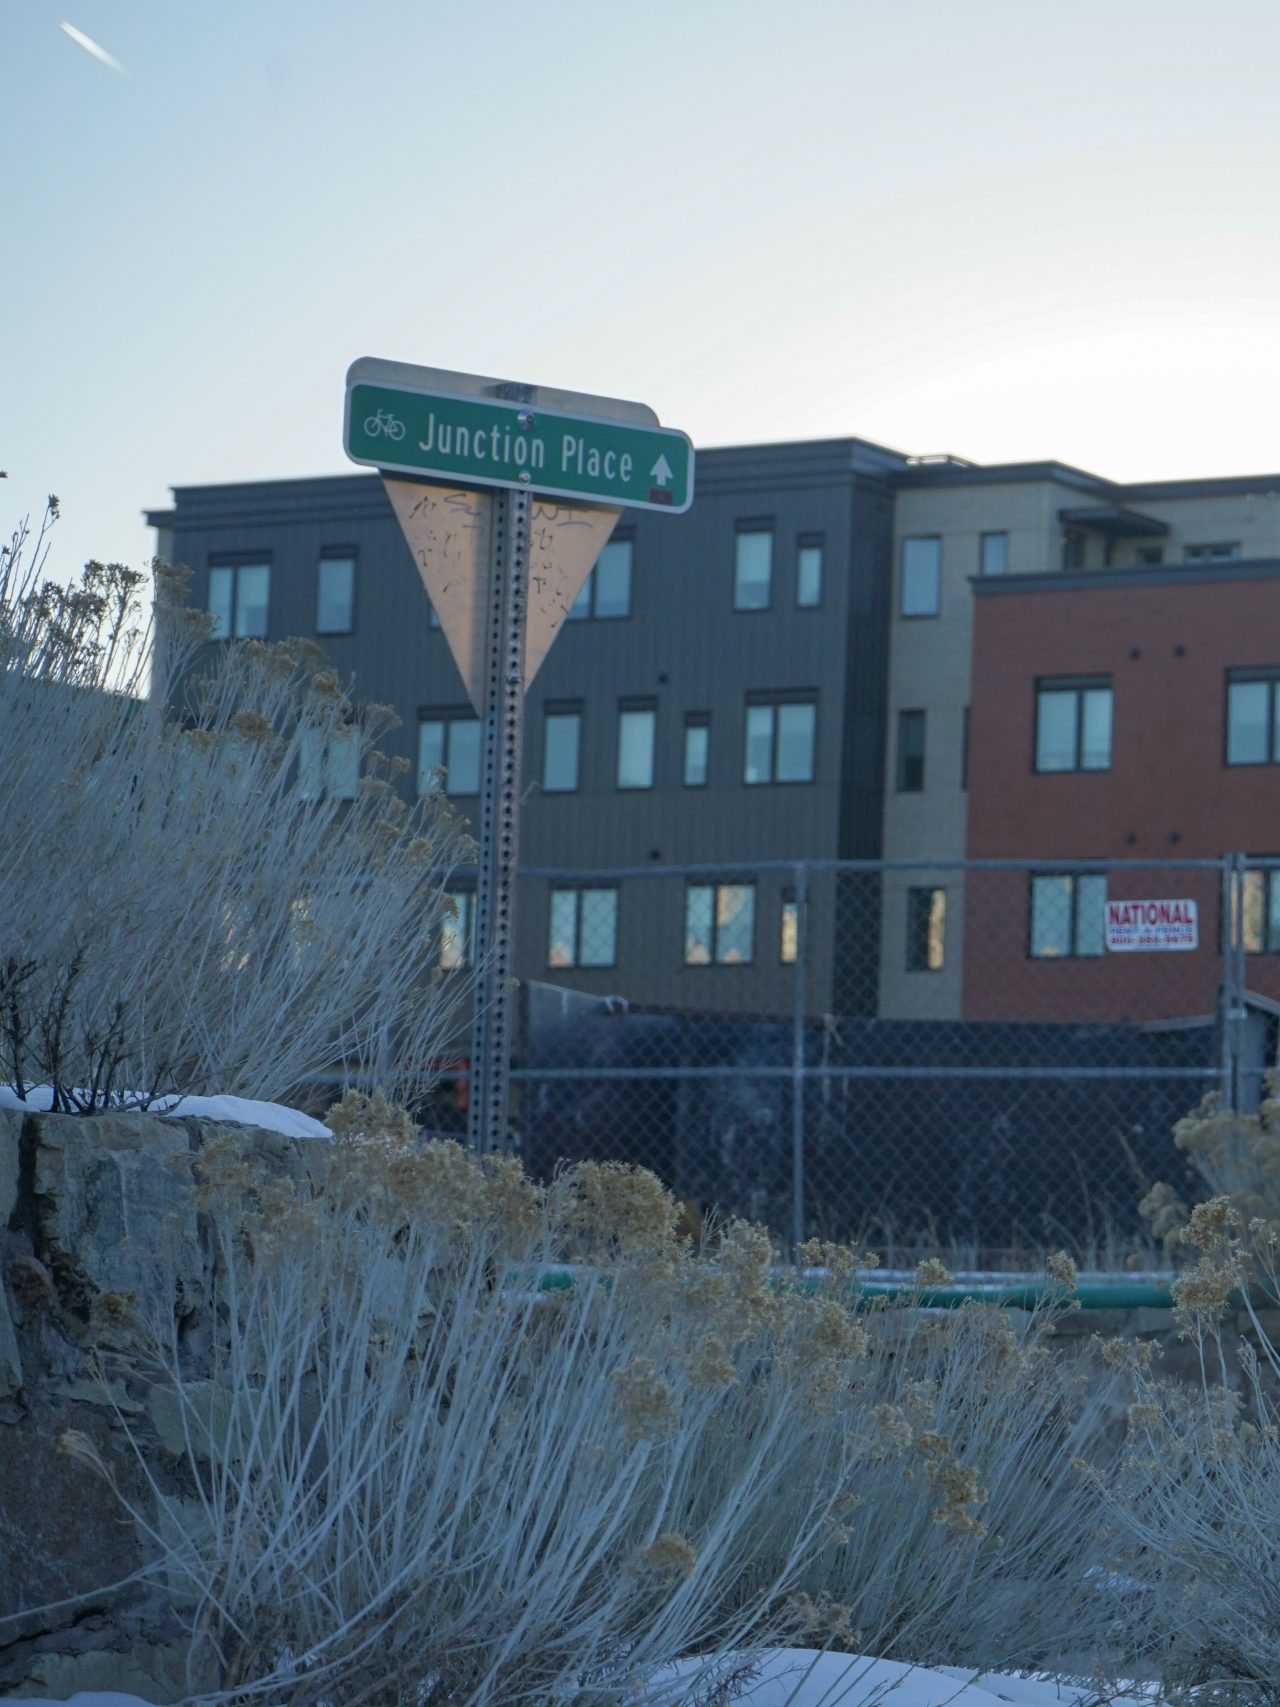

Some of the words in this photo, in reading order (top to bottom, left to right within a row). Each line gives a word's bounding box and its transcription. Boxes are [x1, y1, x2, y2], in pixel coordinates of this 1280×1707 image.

[419, 413, 545, 469] Junction
[561, 434, 632, 482] Place
[1109, 903, 1193, 925] NATIONAL
